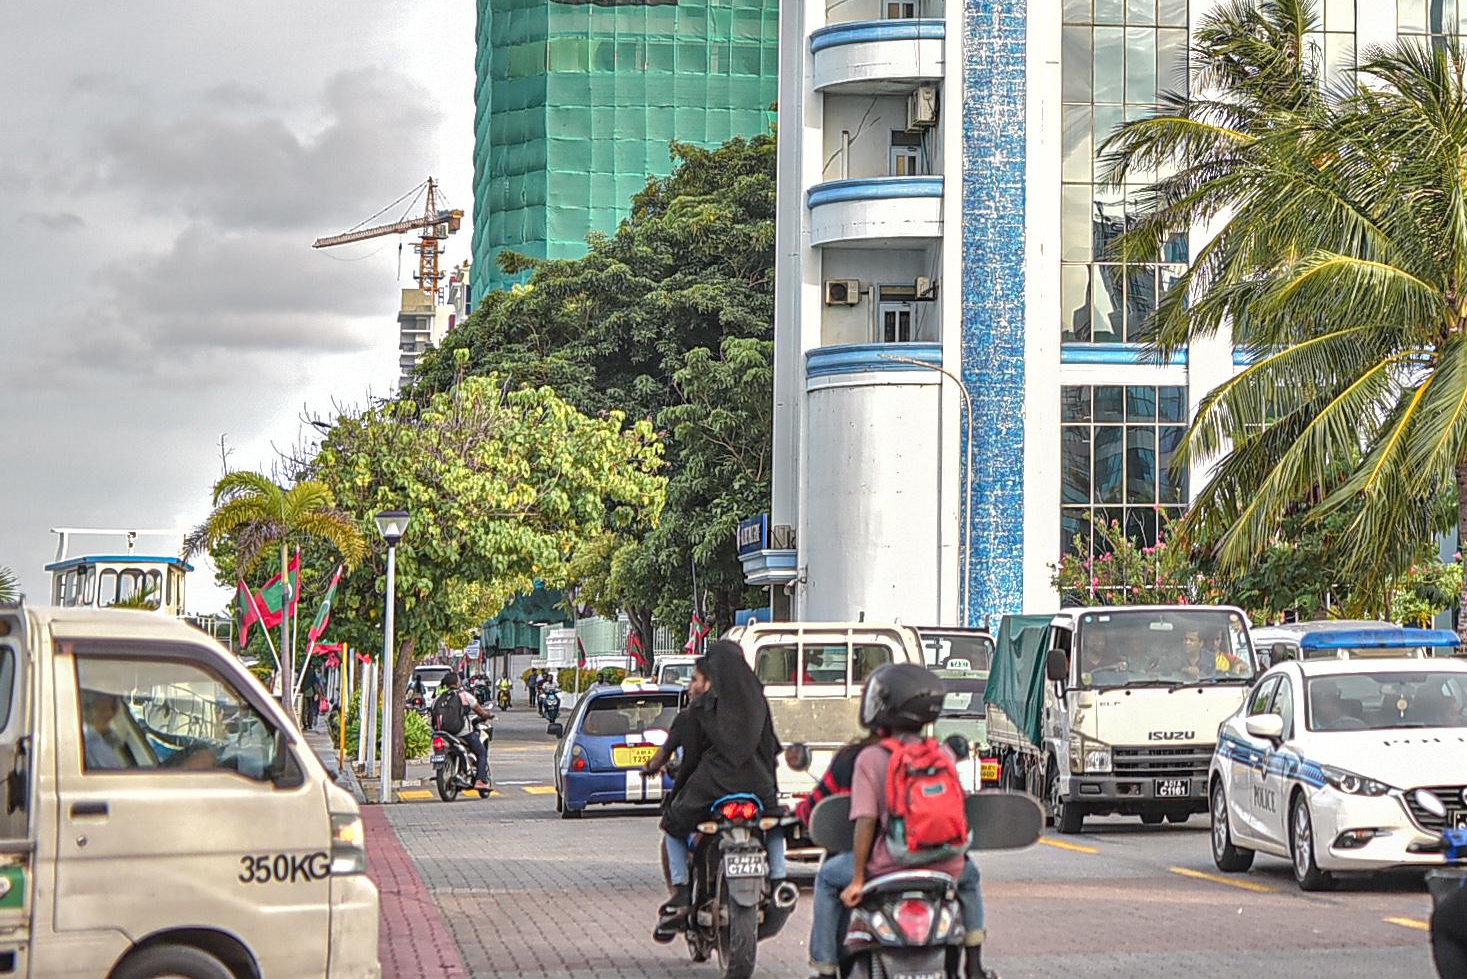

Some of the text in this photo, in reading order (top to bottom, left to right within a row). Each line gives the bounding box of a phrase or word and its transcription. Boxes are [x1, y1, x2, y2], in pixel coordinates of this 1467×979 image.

[1148, 731, 1196, 741] ISUZU
[1253, 784, 1277, 814] POLICE
[237, 851, 332, 884] 350KG
